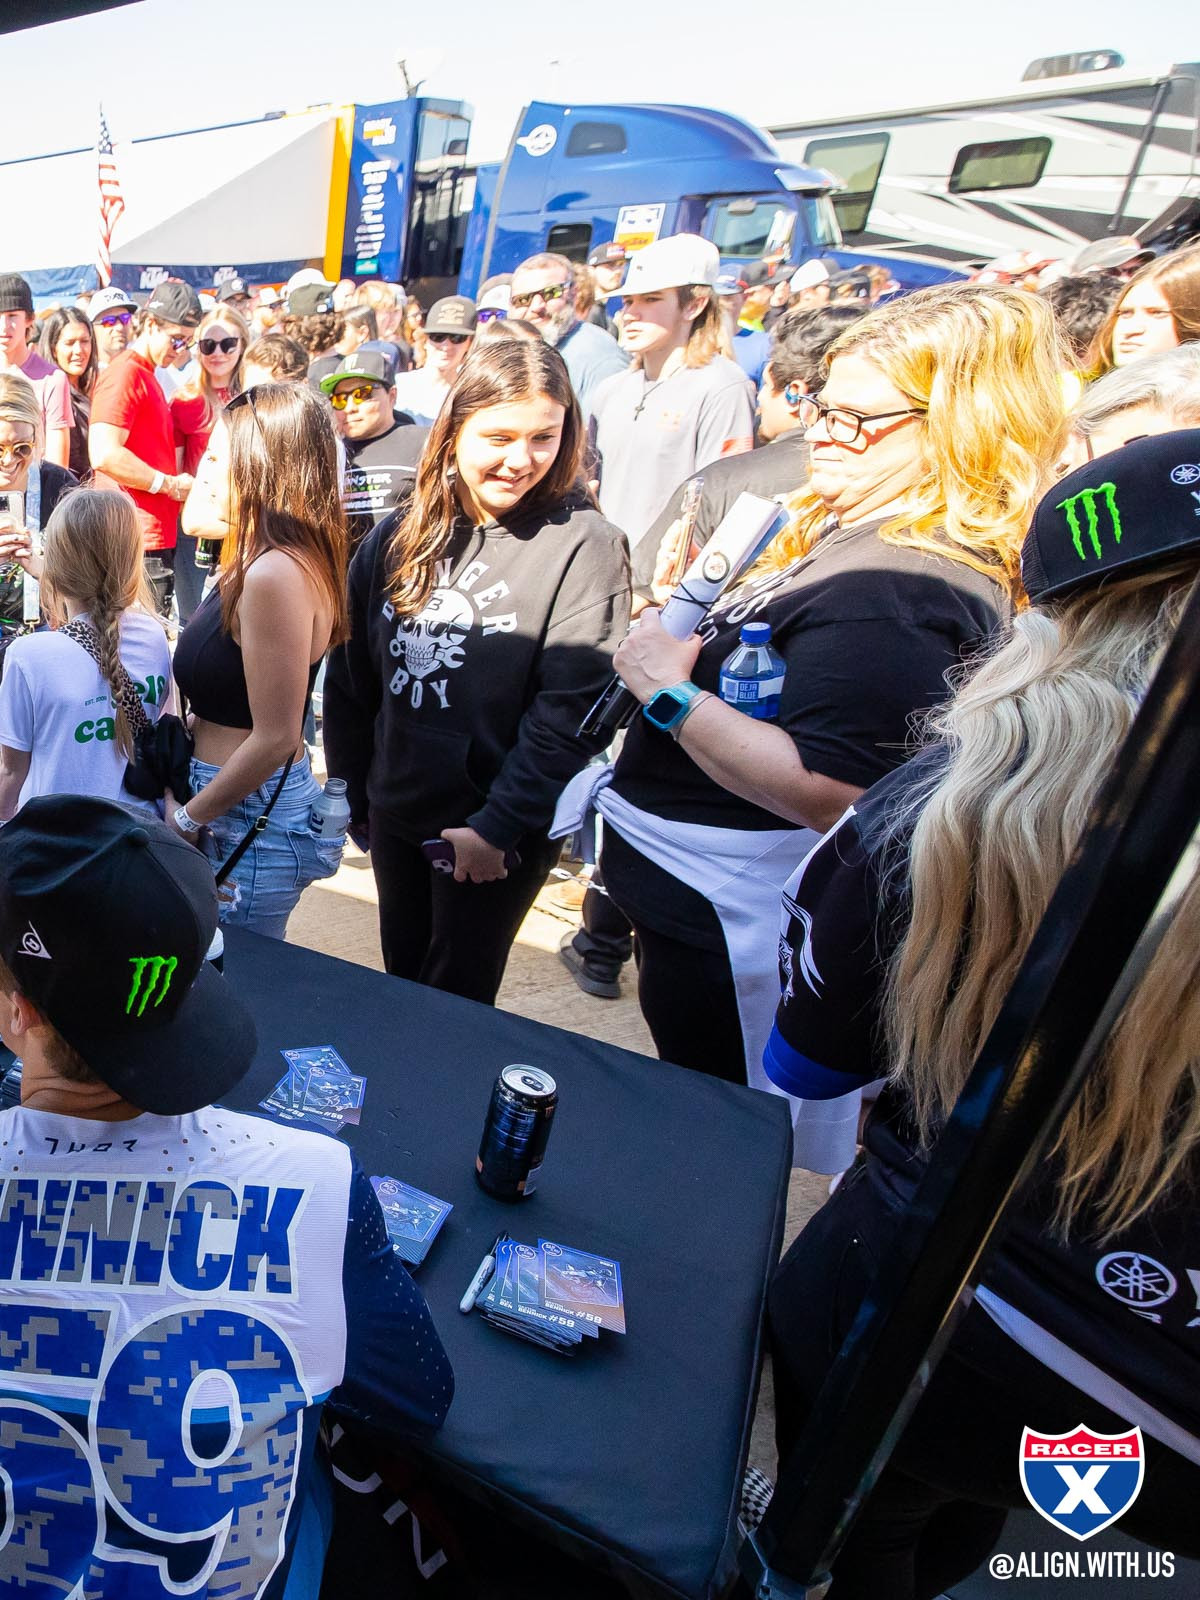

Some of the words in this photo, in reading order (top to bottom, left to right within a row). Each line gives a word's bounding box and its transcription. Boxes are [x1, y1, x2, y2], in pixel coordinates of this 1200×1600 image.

[381, 557, 518, 637] DNGER
[389, 667, 452, 709] BOY
[739, 681, 758, 692] DEJA
[739, 691, 758, 700] BLUE
[518, 1307, 548, 1321] BENNICK
[549, 1315, 576, 1328] #59
[545, 1302, 575, 1316] BENNICK
[576, 1309, 602, 1324] #59
